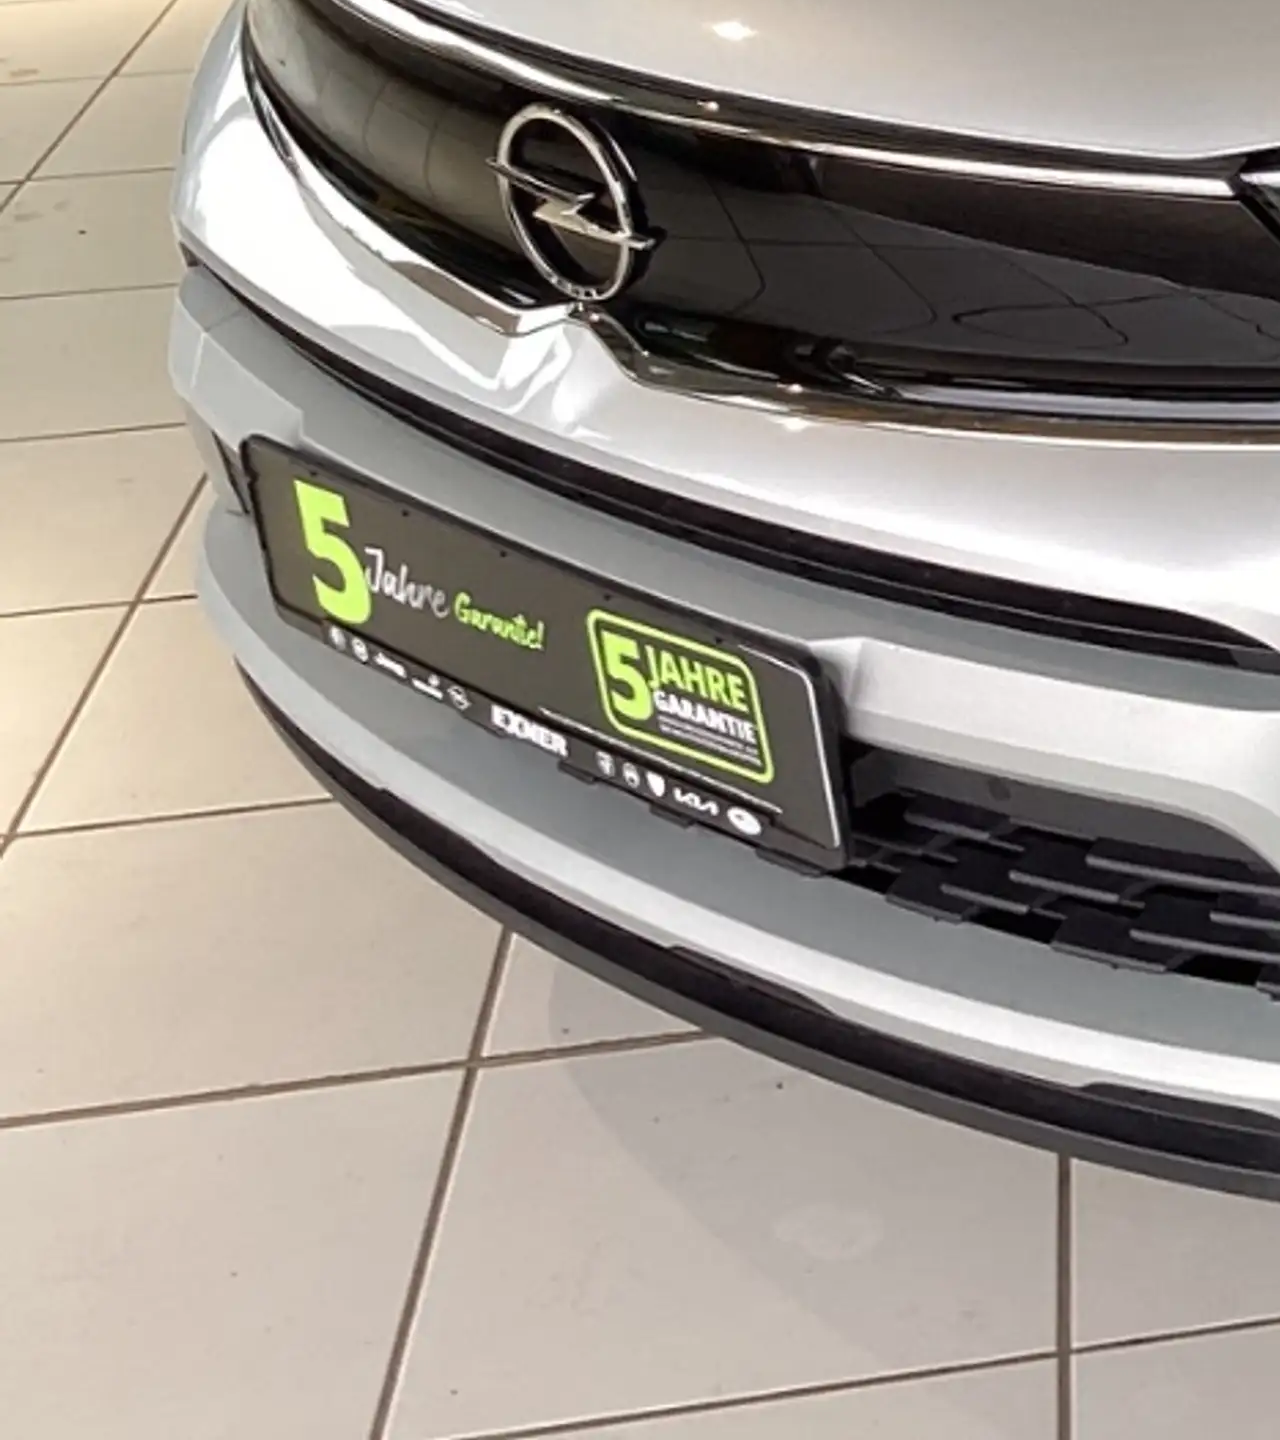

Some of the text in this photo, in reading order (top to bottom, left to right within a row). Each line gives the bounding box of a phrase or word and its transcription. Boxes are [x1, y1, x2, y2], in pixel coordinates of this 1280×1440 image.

[293, 479, 372, 624] 5
[363, 545, 451, 620] Jahre
[601, 629, 750, 721] 5 JAHRE
[653, 689, 759, 746] GARANTIE
